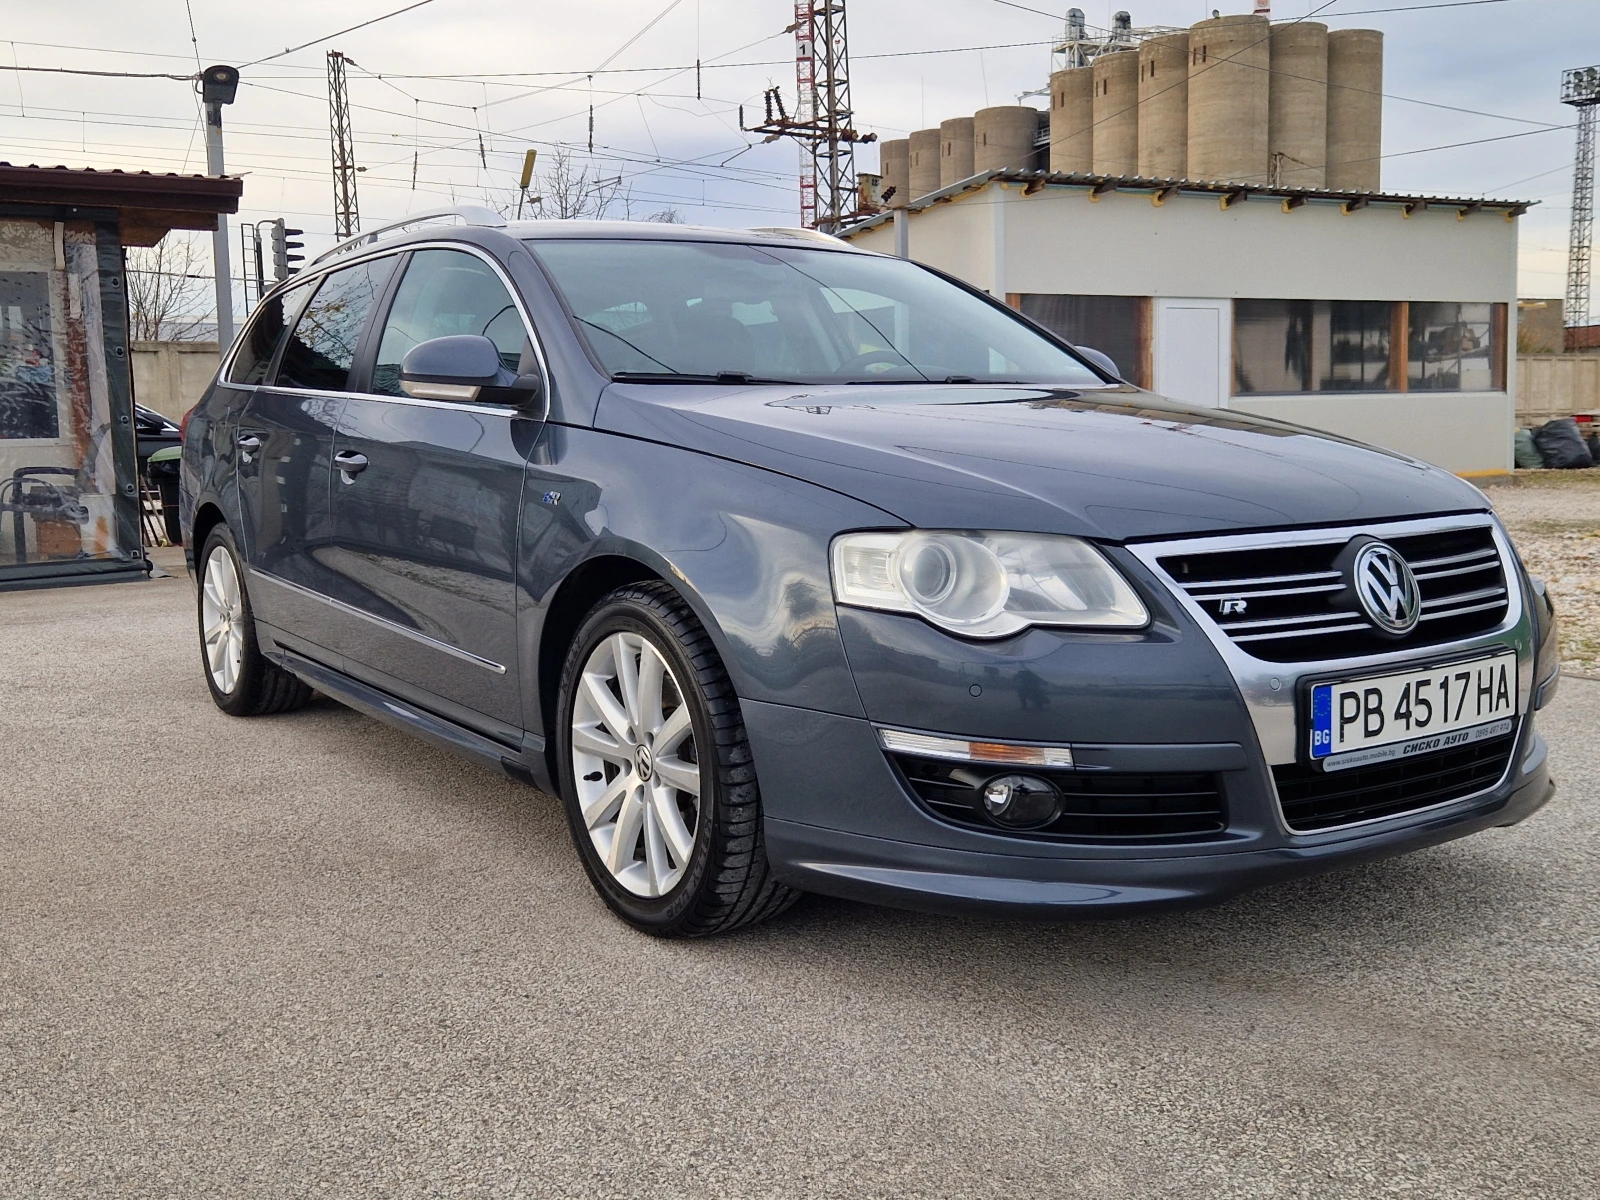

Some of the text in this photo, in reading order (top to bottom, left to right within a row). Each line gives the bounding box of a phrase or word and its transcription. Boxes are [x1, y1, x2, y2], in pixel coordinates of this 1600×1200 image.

[799, 44, 806, 55] 1
[1339, 664, 1510, 743] PB 4517 HA
[1314, 729, 1330, 746] BG
[1402, 738, 1441, 755] СИСКО
[1326, 749, 1396, 767] www.siskoauto.mobile.bg
